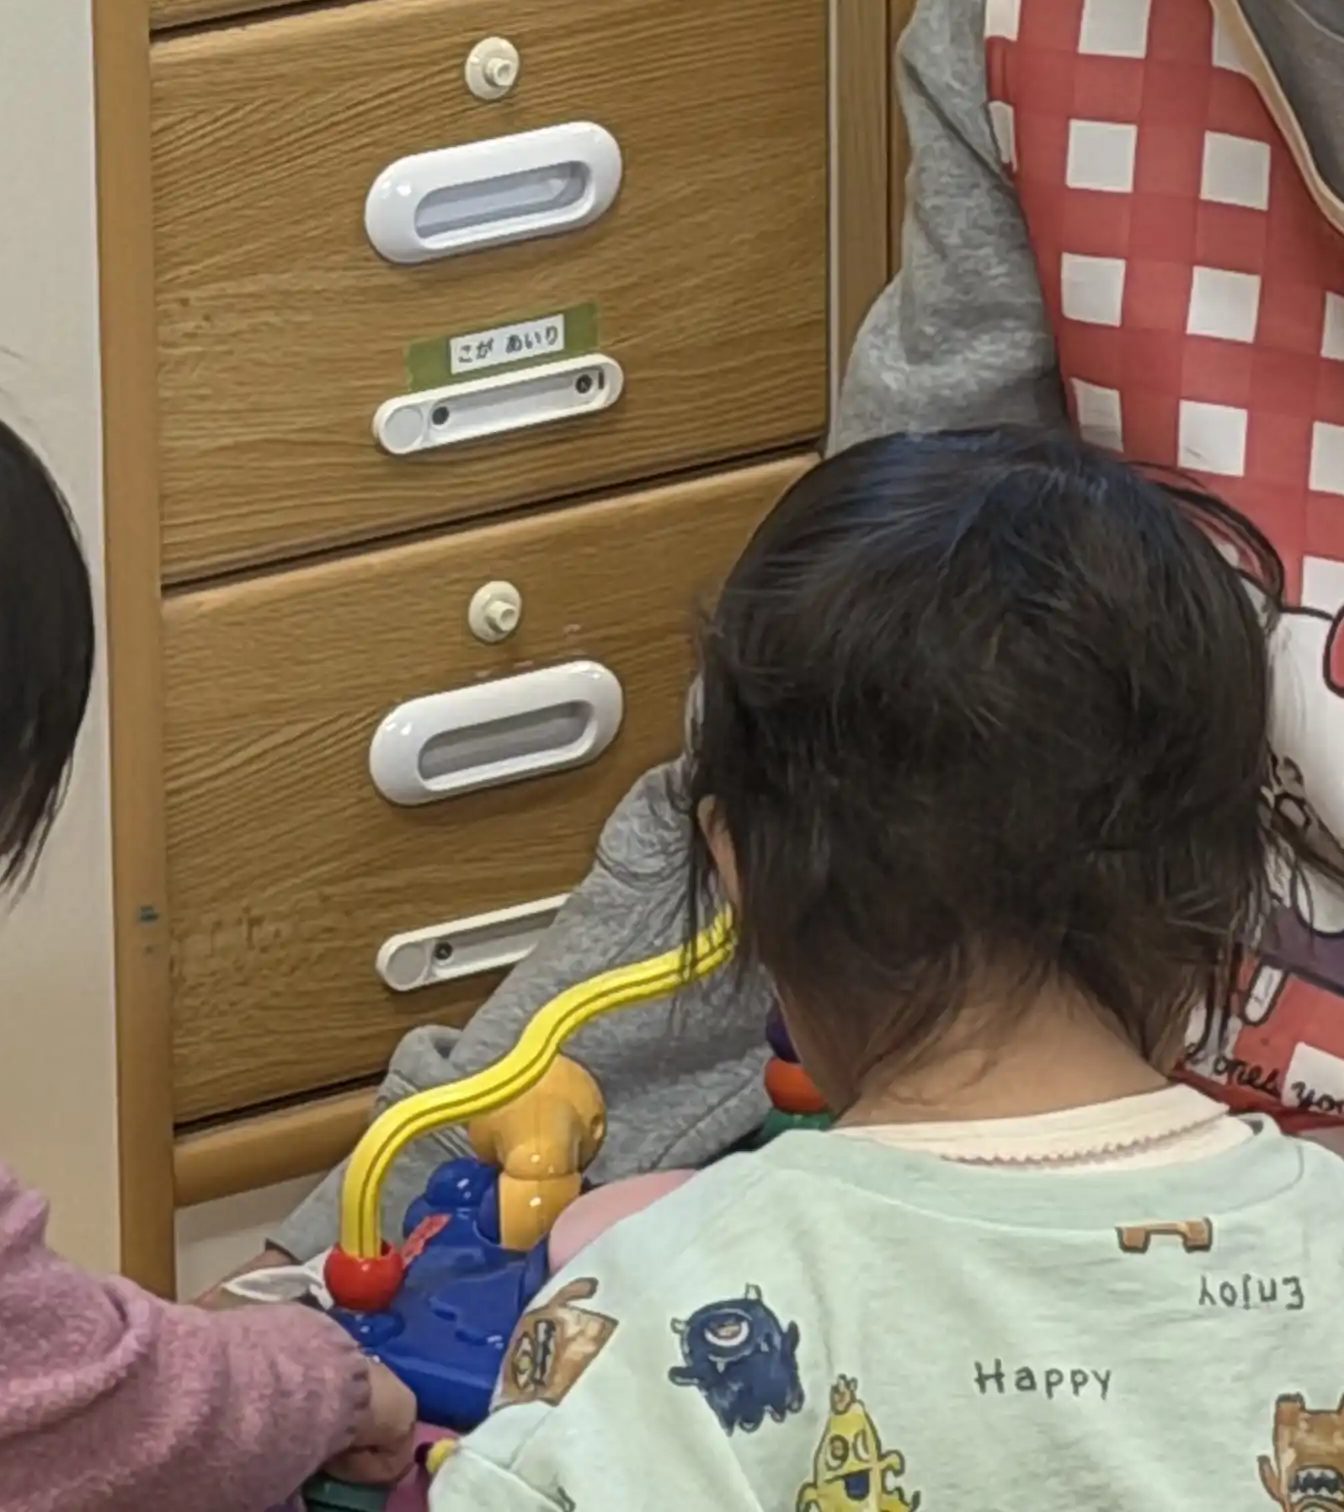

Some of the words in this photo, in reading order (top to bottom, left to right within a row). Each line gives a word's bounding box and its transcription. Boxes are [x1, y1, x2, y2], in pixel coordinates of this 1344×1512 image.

[458, 336, 495, 364] こが
[1198, 1273, 1305, 1310] Enjoy
[973, 1358, 1112, 1399] Happy
